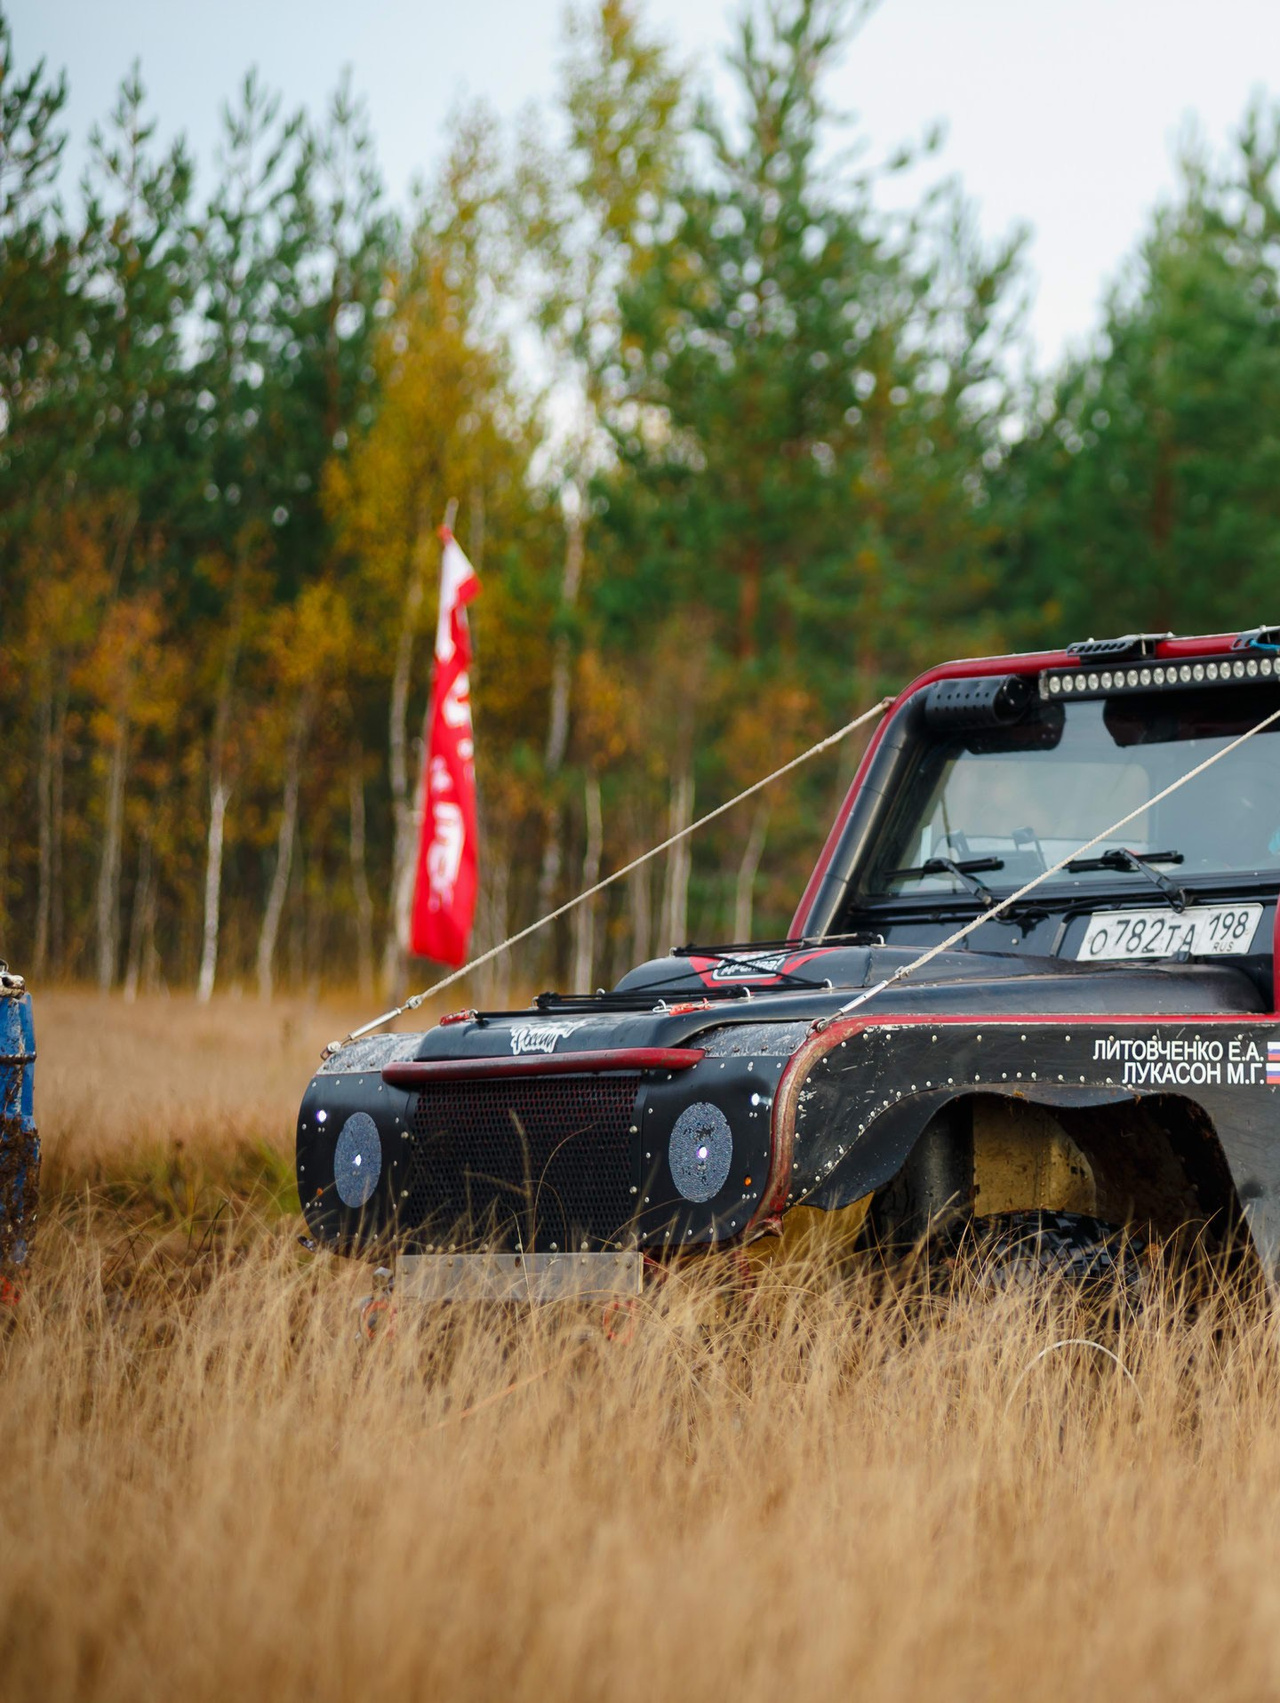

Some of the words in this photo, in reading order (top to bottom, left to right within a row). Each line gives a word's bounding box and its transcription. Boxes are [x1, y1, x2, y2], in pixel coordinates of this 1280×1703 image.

[1209, 911, 1249, 941] 198
[1212, 941, 1235, 953] RUS
[1093, 1040, 1223, 1061] ЛИТОВЧЕНКО
[1228, 1041, 1264, 1061] Е.А.
[1122, 1062, 1221, 1084] ЛУКАСОН
[1227, 1062, 1265, 1084] М.Г.
